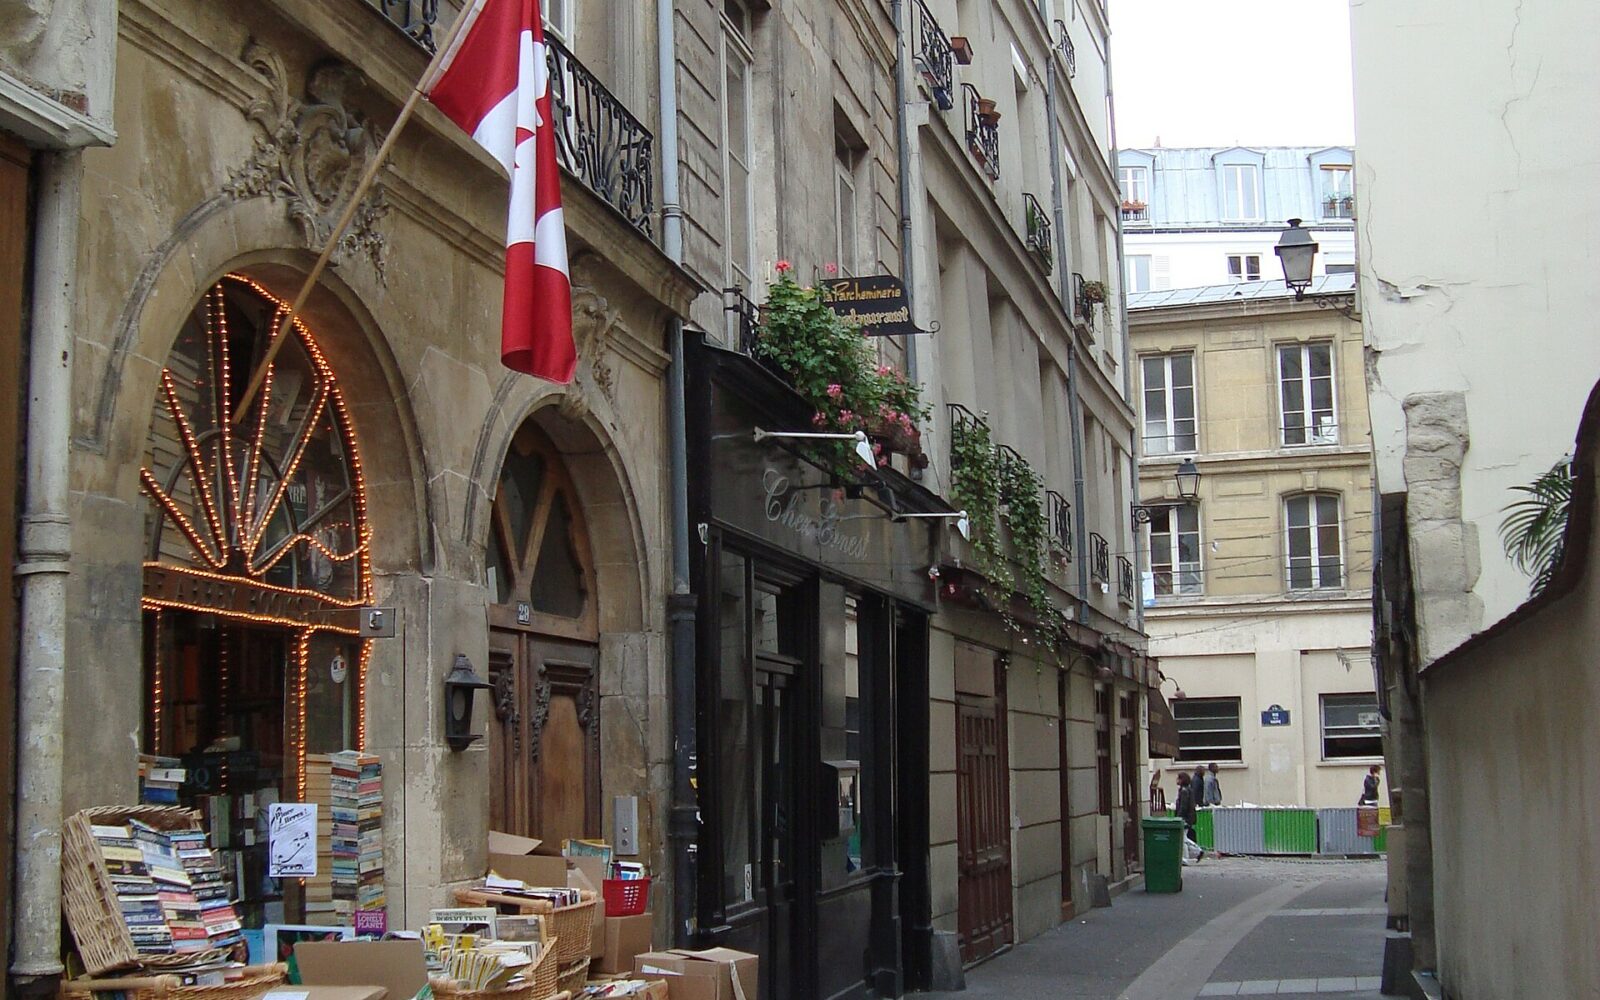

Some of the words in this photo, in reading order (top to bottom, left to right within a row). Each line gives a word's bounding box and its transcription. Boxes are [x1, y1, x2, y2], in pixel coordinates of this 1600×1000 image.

[832, 281, 902, 302] Parcheminerie
[828, 306, 909, 325] staurant
[357, 915, 384, 923] LONELY
